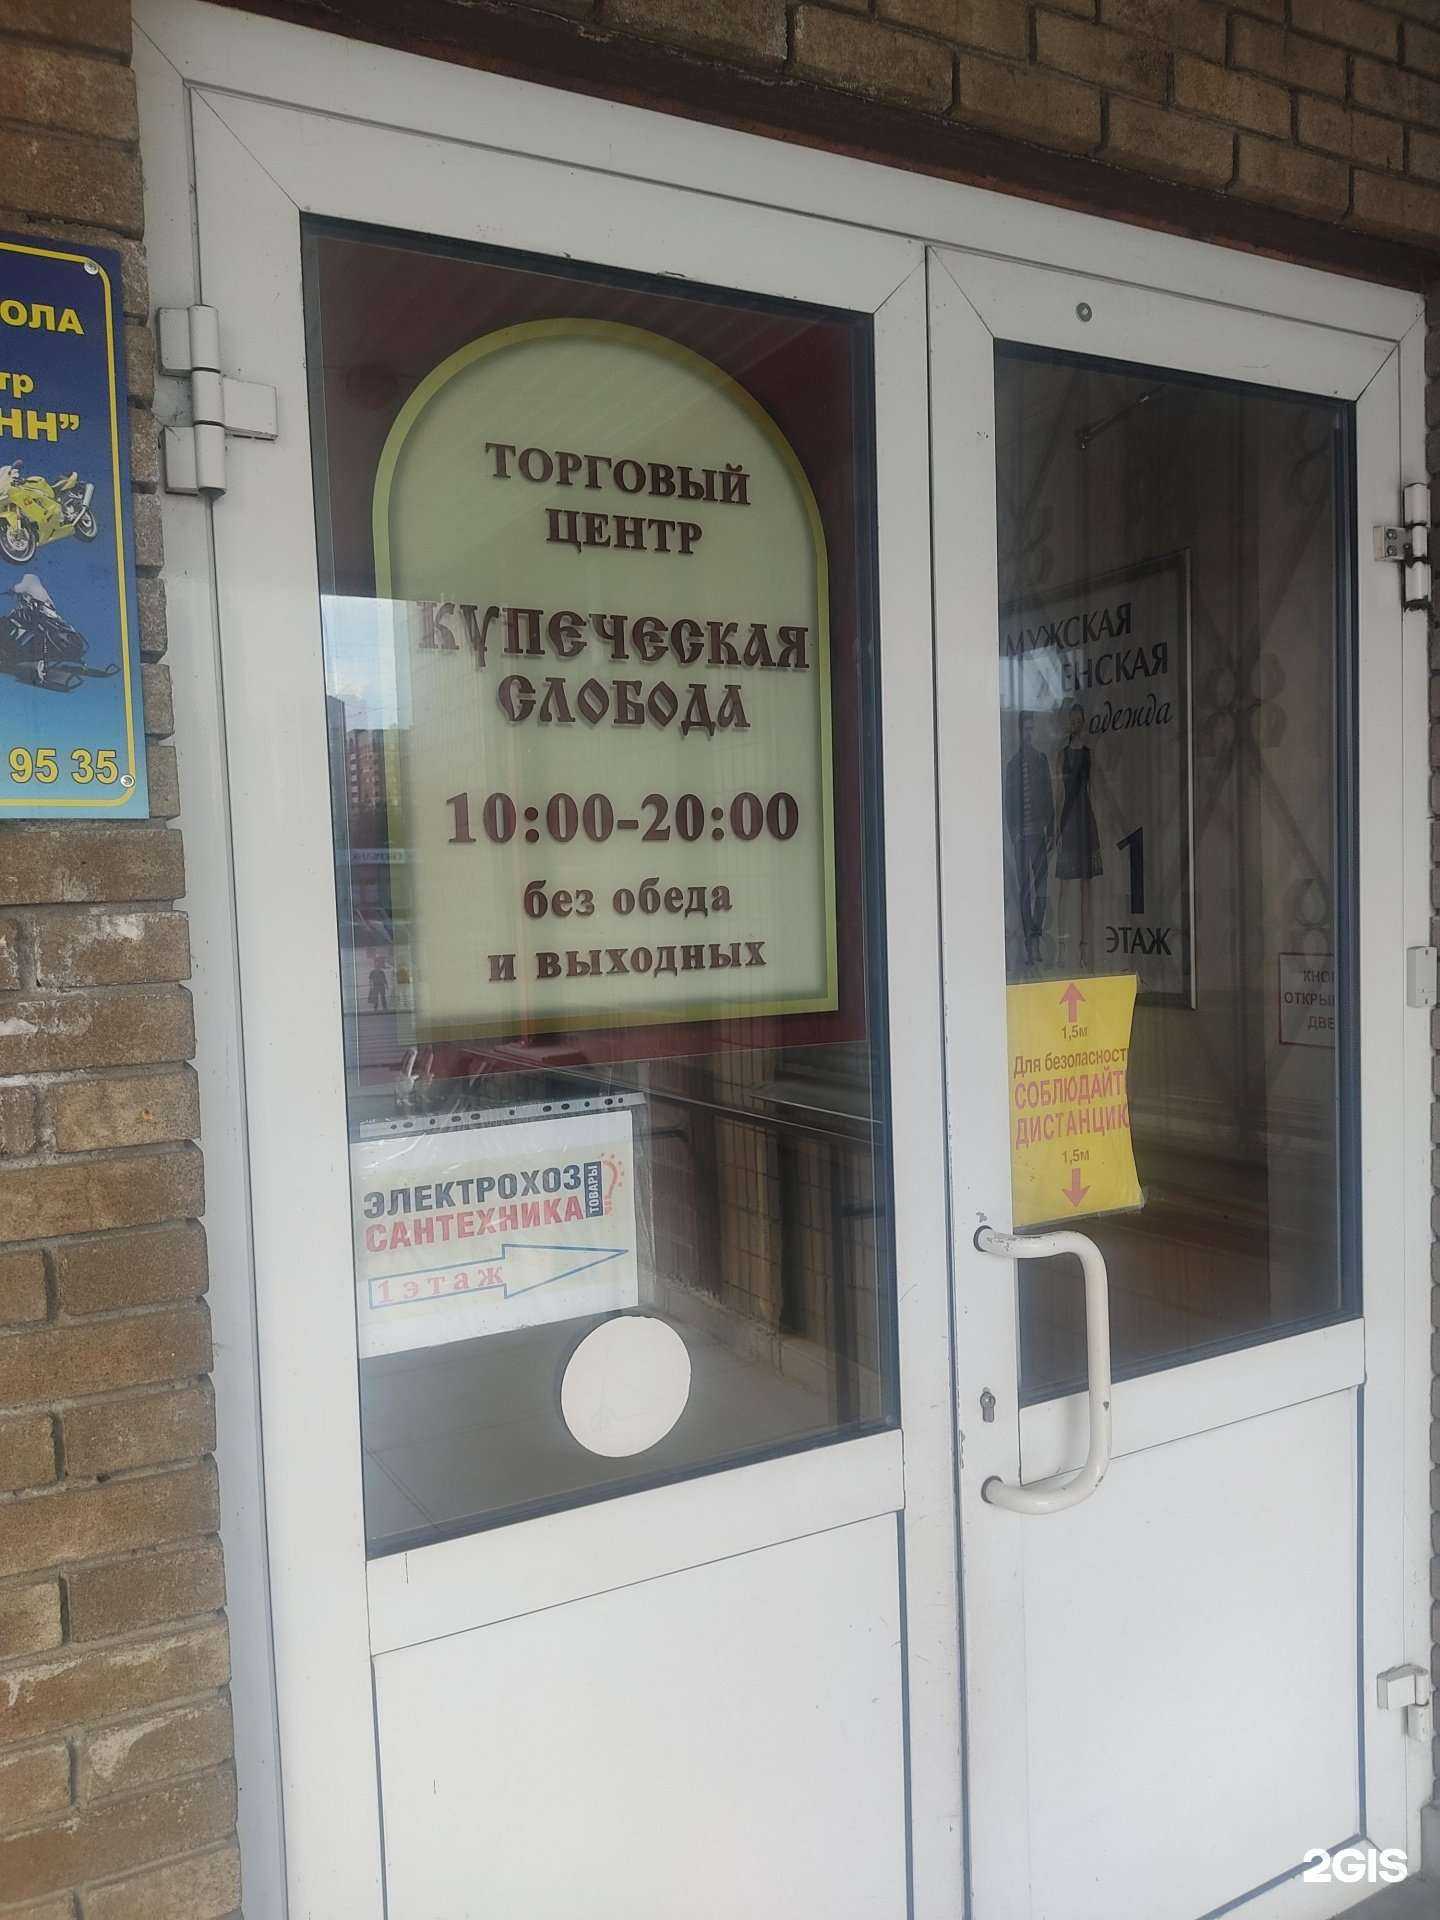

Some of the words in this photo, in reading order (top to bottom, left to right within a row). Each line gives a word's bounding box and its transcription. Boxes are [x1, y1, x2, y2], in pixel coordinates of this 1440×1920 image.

[485, 442, 751, 505] ТОРГОВЫЙ
[545, 508, 703, 554] ЦЕНТР
[416, 601, 810, 668] КУПЕЧЕСКАЯ
[1007, 602, 1132, 656] МУЖСКАЯ
[499, 675, 751, 736] СЛОБОДА
[1089, 694, 1173, 734] одежда
[9, 747, 59, 784] 95
[71, 748, 119, 784] 35
[446, 792, 800, 844] 10:00-20:00
[1116, 827, 1145, 914] 1
[524, 880, 595, 918] без
[612, 877, 733, 917] обеда
[488, 953, 517, 982] и
[536, 941, 768, 979] выходных
[1105, 926, 1173, 956] ЭТАЖ
[1062, 1025, 1088, 1040] 1,5м
[1014, 1055, 1041, 1077] Для
[1045, 1047, 1128, 1072] безопасност
[1014, 1068, 1127, 1110] СОБЛЮДАЙТ
[1062, 1149, 1089, 1165] 1,5м
[364, 1164, 582, 1219] ЭЛЕКТРОХОЗ
[588, 1163, 600, 1214] ТОВАРЫ
[365, 1195, 585, 1253] САНТЕХНИКА
